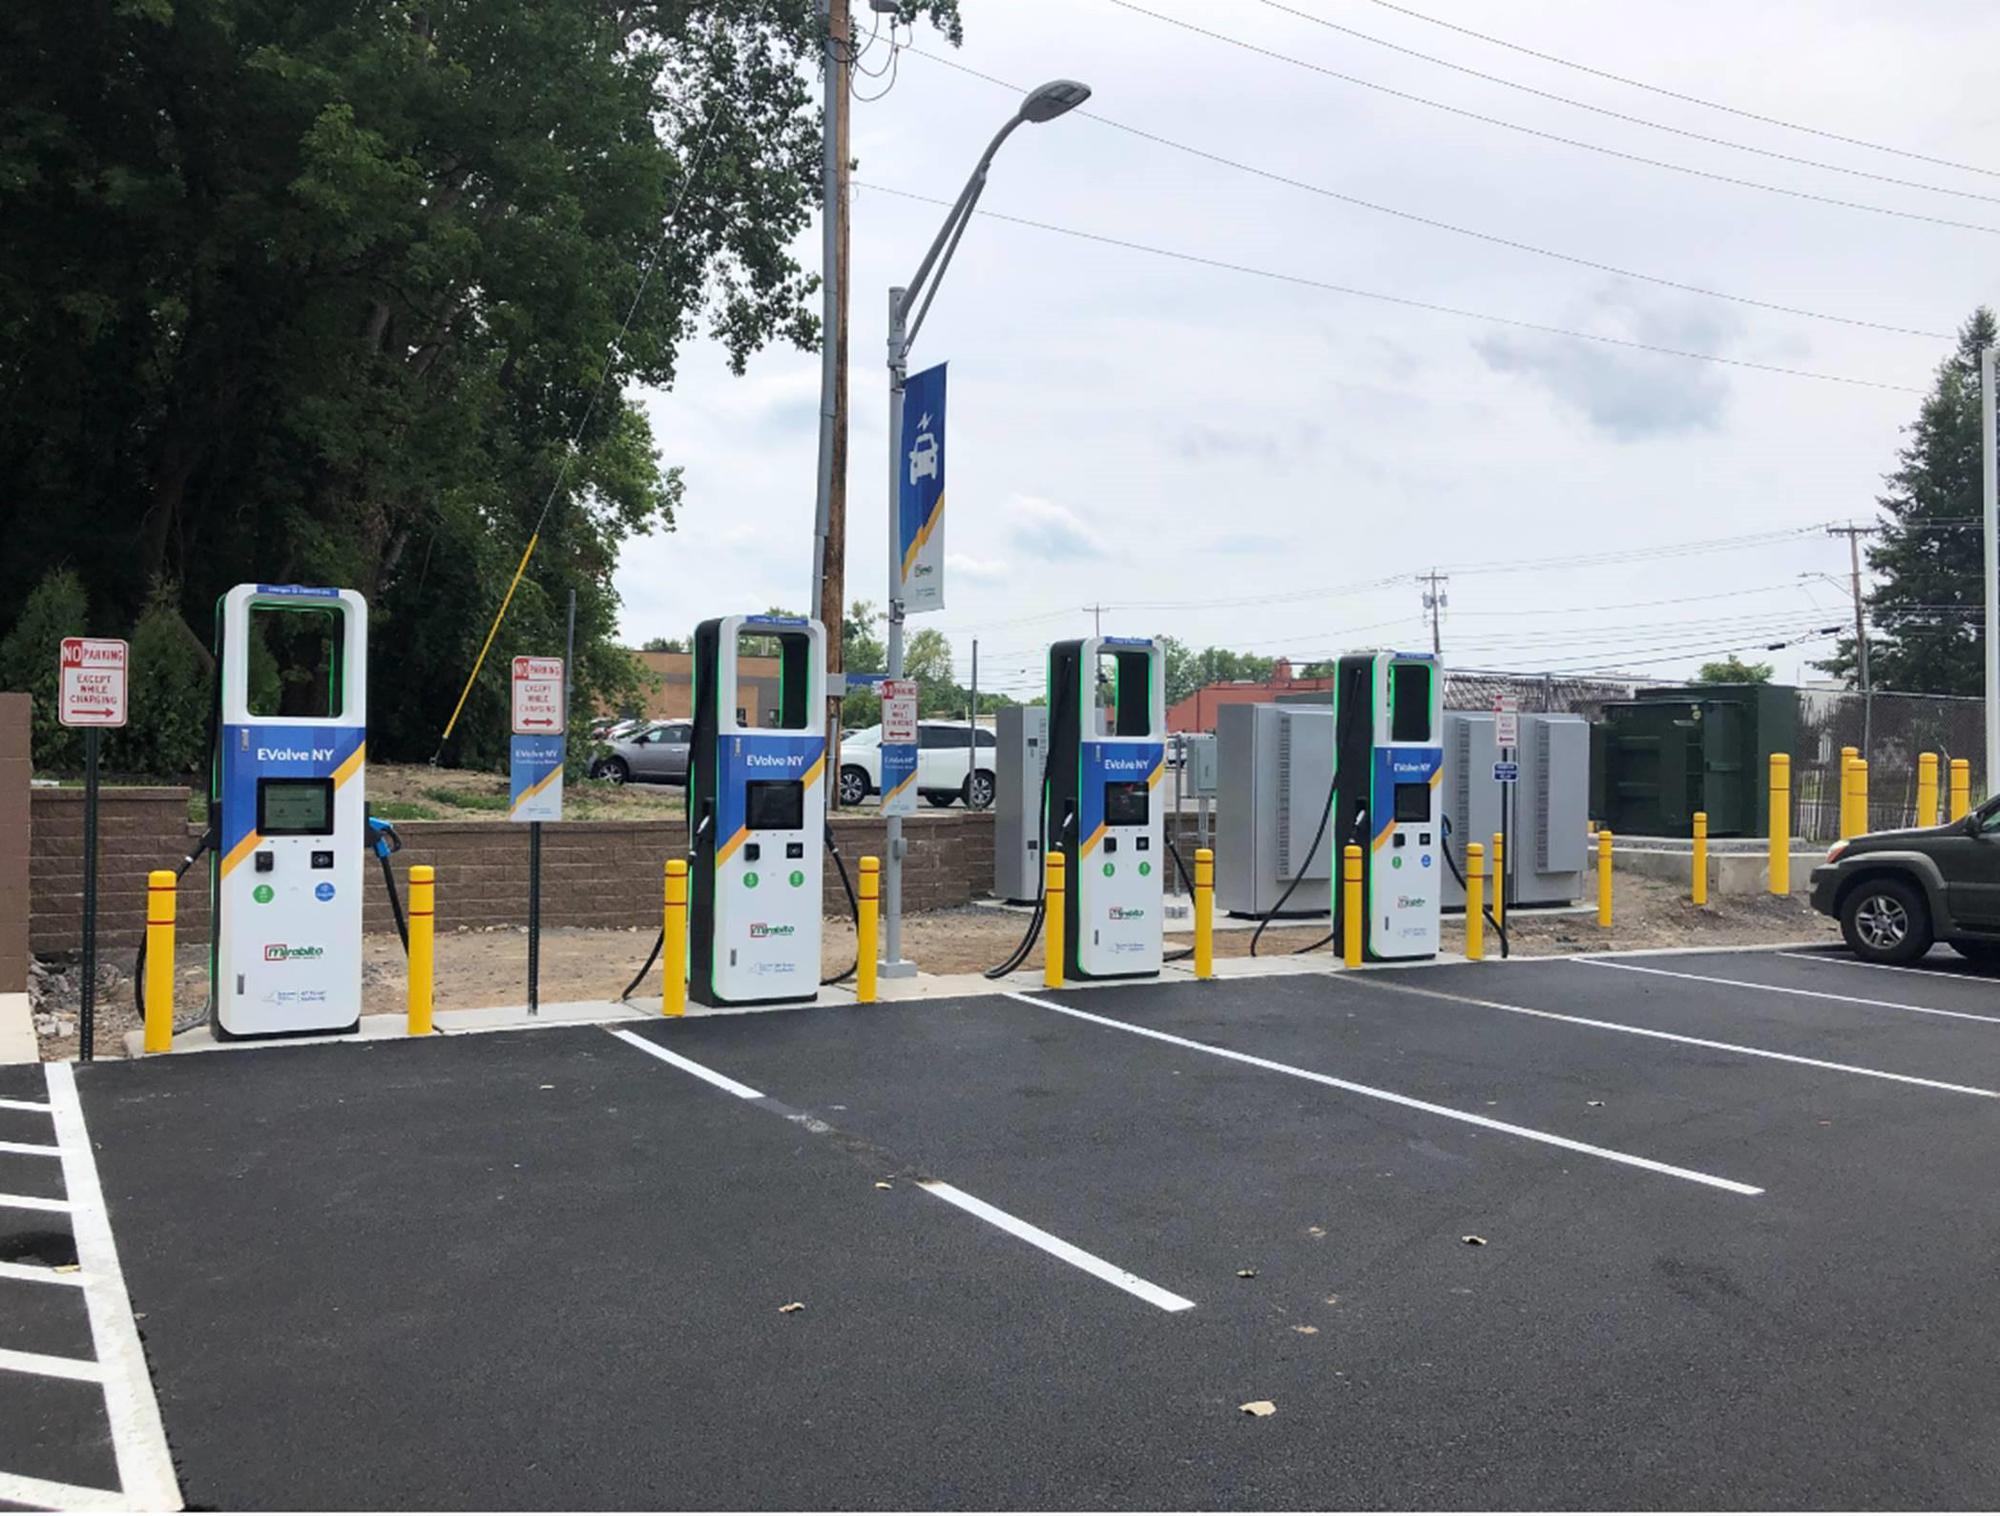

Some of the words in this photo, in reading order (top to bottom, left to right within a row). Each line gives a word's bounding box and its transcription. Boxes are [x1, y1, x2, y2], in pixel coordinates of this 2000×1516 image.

[64, 646, 81, 662] NO
[84, 649, 123, 661] PARKING
[515, 662, 528, 677] NO
[530, 665, 560, 676] PARKING
[76, 674, 111, 683] EXCEPT
[81, 685, 108, 694] WHILE
[69, 695, 118, 705] CHARGING
[257, 747, 309, 760] EVolve
[312, 748, 334, 761] NY
[545, 749, 558, 758] NY
[746, 755, 786, 767] EVolve
[787, 755, 804, 767] NY
[1104, 758, 1135, 770] EVolve
[1136, 759, 1149, 770] NY
